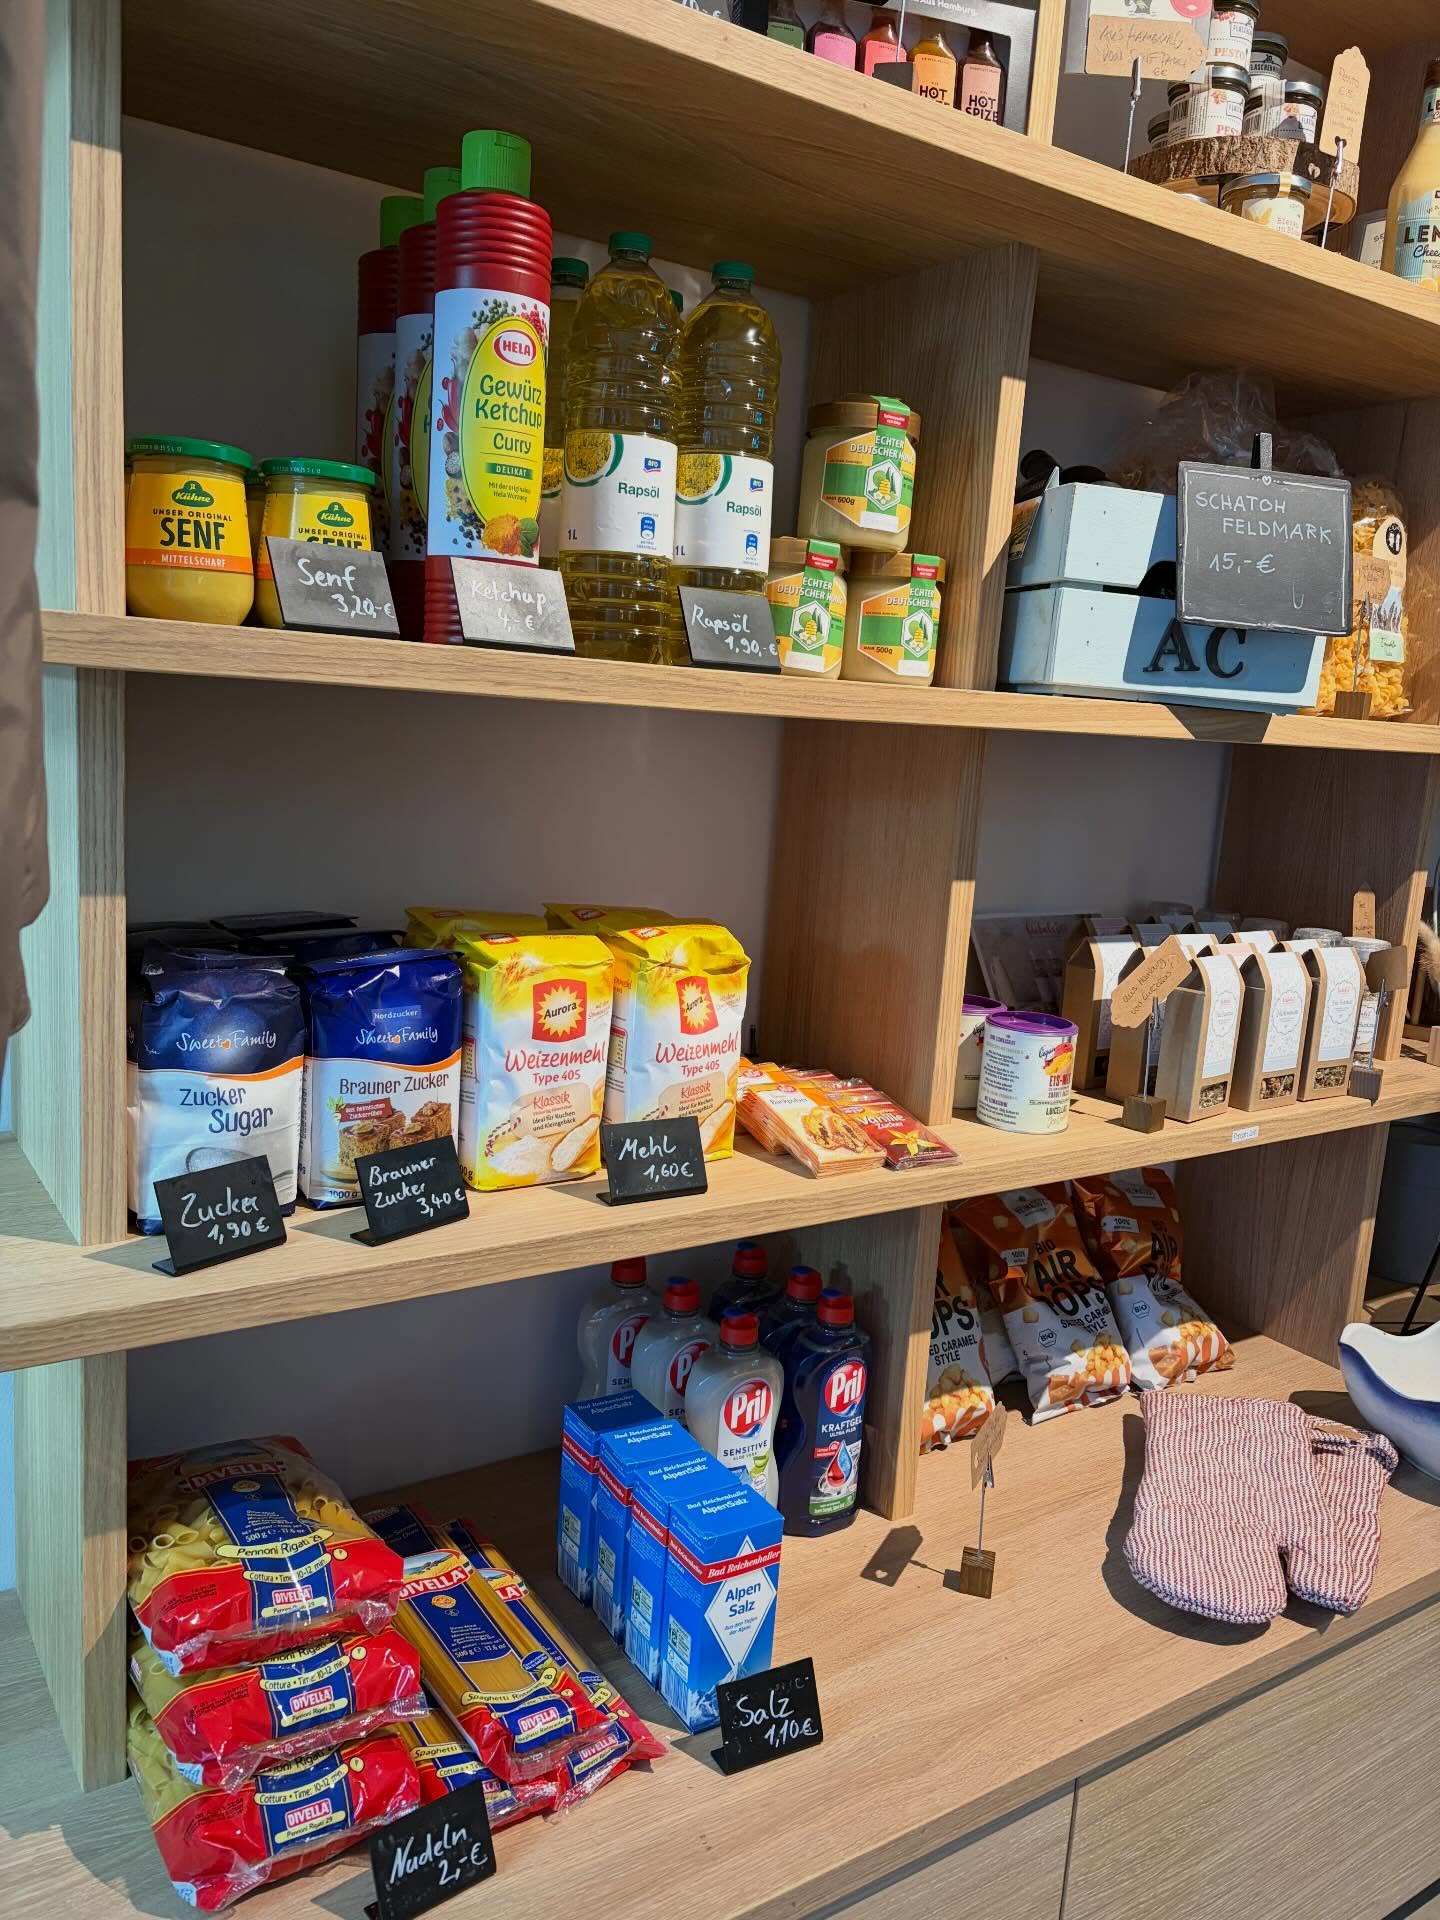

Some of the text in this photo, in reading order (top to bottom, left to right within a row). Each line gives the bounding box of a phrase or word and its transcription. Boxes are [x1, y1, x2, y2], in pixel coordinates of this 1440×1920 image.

[920, 85, 948, 100] HOT
[969, 94, 996, 109] HOT
[503, 340, 531, 357] HELA
[479, 374, 542, 406] Gewürz
[475, 398, 543, 429] Ketchup
[493, 432, 532, 455] Curry
[850, 443, 897, 459] DEUTSCHER
[875, 435, 905, 449] ECHTER
[495, 465, 528, 477] DELIKAT
[175, 491, 211, 503] Kühne
[618, 482, 660, 499] Rapsöl
[152, 508, 233, 522] UNSER ORIGINAL
[320, 511, 352, 523] Kühne
[726, 501, 762, 517] Rapsöl
[160, 517, 225, 551] SENF
[298, 527, 368, 540] UNSER ORIGINAL
[1223, 518, 1333, 545] FELDMARK
[161, 554, 226, 568] MITTELSCHARF
[298, 558, 357, 592] Senf
[802, 576, 832, 590] ECHTER
[470, 579, 547, 615] Ketchup
[777, 584, 825, 600] DEUTSCHER
[910, 588, 934, 598] ECHTER
[886, 596, 929, 608] DEUTSCHER
[692, 604, 750, 634] Rapsöl
[374, 1008, 418, 1020] Nordzucker
[543, 1001, 578, 1019] Aurora
[504, 1040, 606, 1072] Weizenmehl
[655, 1032, 738, 1063] Weizenmehl
[533, 1069, 581, 1086] Type 405
[681, 1060, 720, 1077] Type 405
[339, 1072, 450, 1096] Brauner Zucker
[681, 1081, 711, 1098] Klassik
[179, 1086, 247, 1107] Zucker
[533, 1091, 570, 1109] Klassik
[208, 1107, 274, 1137] Sugar
[618, 1136, 677, 1161] Mehl
[370, 1156, 437, 1187] Brauner
[373, 1182, 426, 1209] Zucker
[180, 1187, 260, 1229] Zucker
[1033, 1250, 1083, 1292] AIR
[941, 1334, 978, 1353] CARAMEL
[934, 1350, 960, 1366] STYLE
[830, 1366, 864, 1409] Pril
[730, 1386, 769, 1429] Pril
[821, 1415, 862, 1433] KRAFTGEL
[614, 1432, 628, 1440] Bad
[723, 1440, 768, 1457] SENSITIVE
[191, 1461, 279, 1489] DIVELLA
[649, 1468, 663, 1476] Bad
[687, 1489, 748, 1510] Bad Reichenhaller
[702, 1497, 749, 1515] AlpenSalz
[237, 1539, 310, 1556] Pennoni Rigati
[707, 1551, 780, 1578] Bad Reichenhaller
[250, 1572, 274, 1581] Cottura
[725, 1583, 761, 1602] Alpen
[729, 1600, 755, 1618] Salz
[264, 1680, 291, 1690] Cottura
[293, 1689, 331, 1711] DIVELLA
[467, 1693, 509, 1703] Spaghetti
[738, 1690, 795, 1727] Salz
[521, 1709, 558, 1733] DIVELLA
[415, 1746, 458, 1759] Spaghetti
[260, 1794, 287, 1804] Cottura
[287, 1802, 330, 1827] DIVELLA
[390, 1823, 468, 1884] Nudeln
